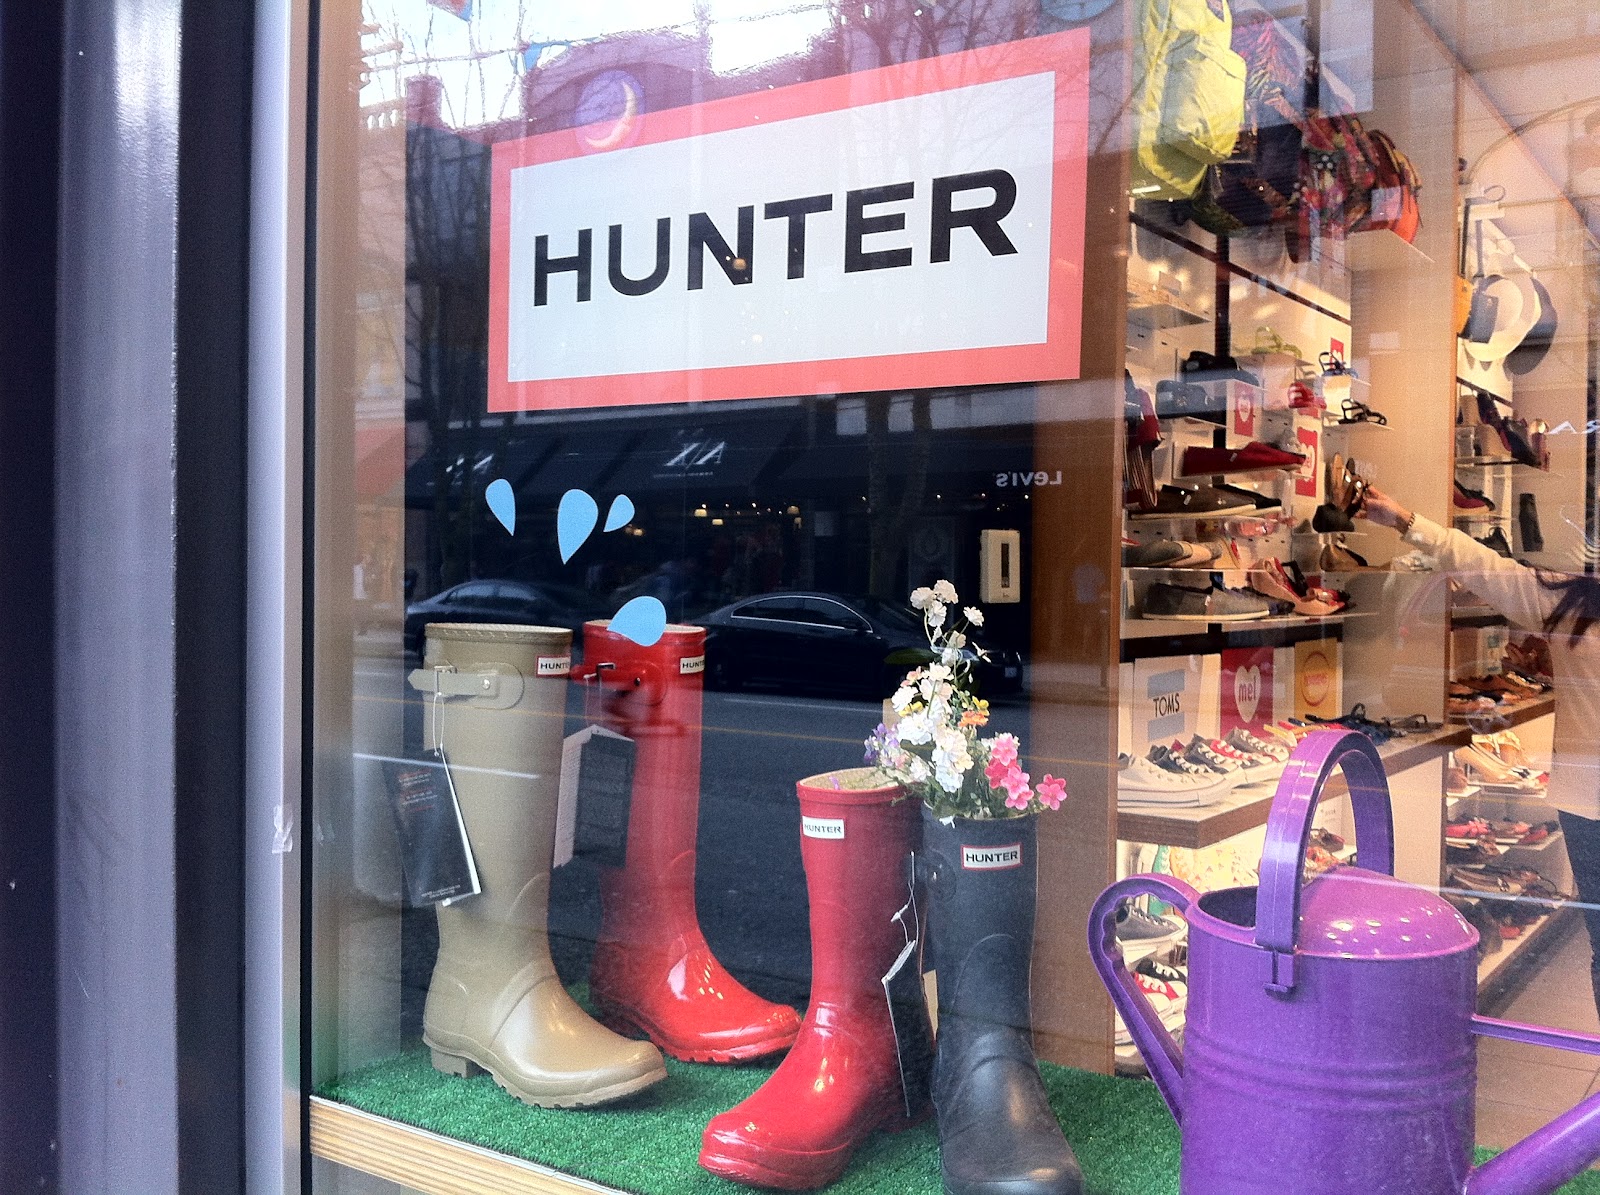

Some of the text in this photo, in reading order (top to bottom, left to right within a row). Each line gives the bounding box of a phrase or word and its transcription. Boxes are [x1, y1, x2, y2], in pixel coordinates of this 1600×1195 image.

[534, 168, 1018, 306] HUNTER
[1238, 676, 1257, 703] mel
[1153, 693, 1180, 718] TOMS
[804, 823, 843, 835] HUNTER
[965, 850, 1019, 864] HUNTER
